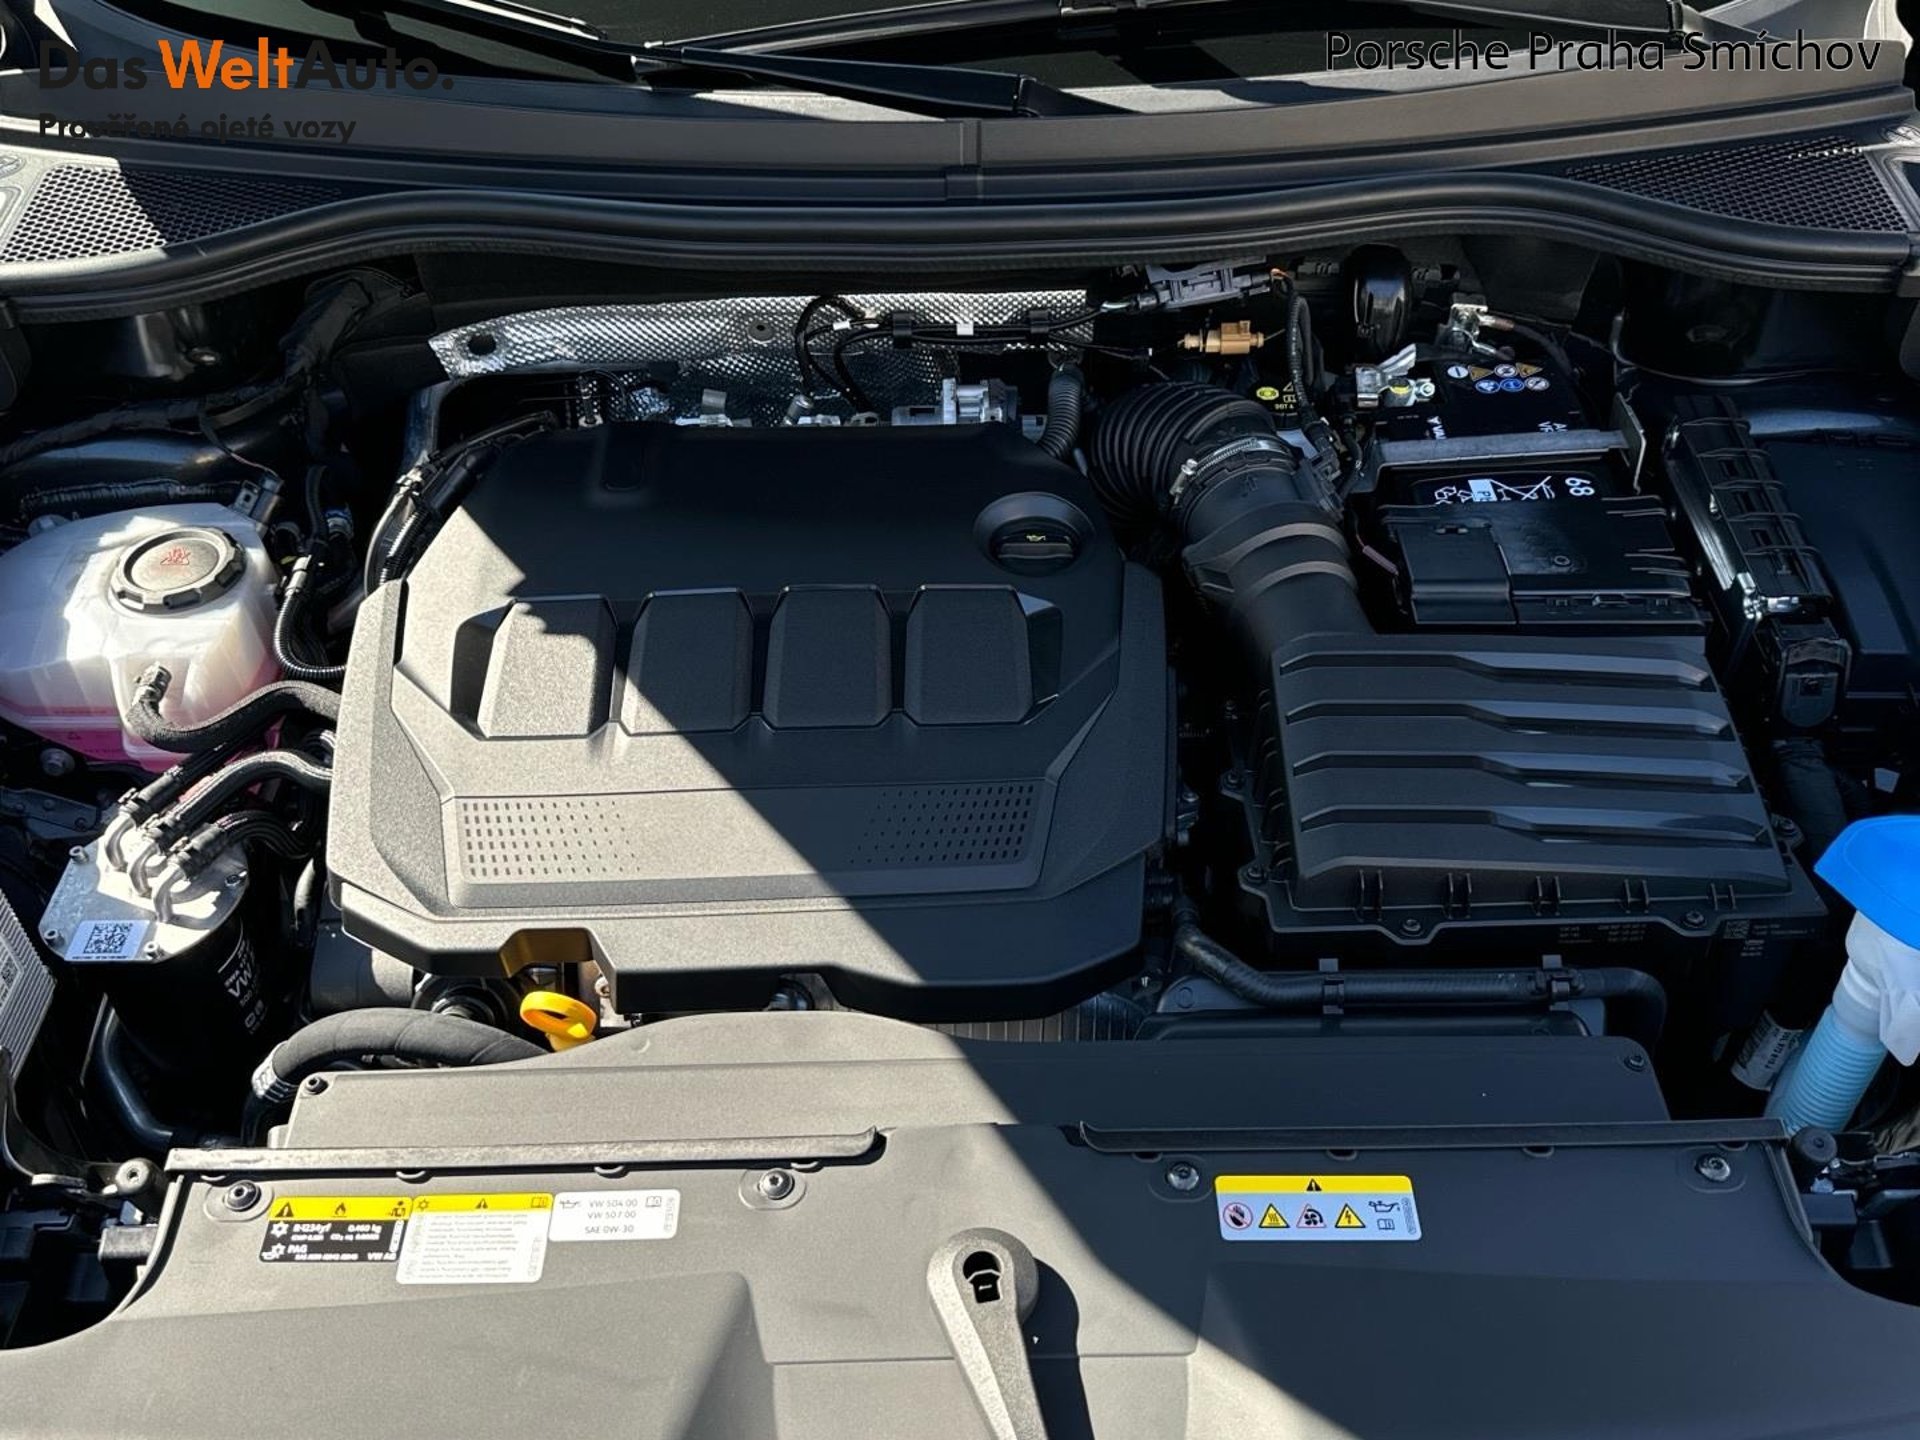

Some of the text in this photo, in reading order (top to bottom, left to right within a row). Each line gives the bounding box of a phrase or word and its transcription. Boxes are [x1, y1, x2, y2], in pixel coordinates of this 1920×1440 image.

[1564, 476, 1596, 497] 68
[625, 1199, 638, 1207] 00
[624, 1210, 637, 1218] 00
[585, 1226, 600, 1234] SAE
[287, 1244, 308, 1254] PAG
